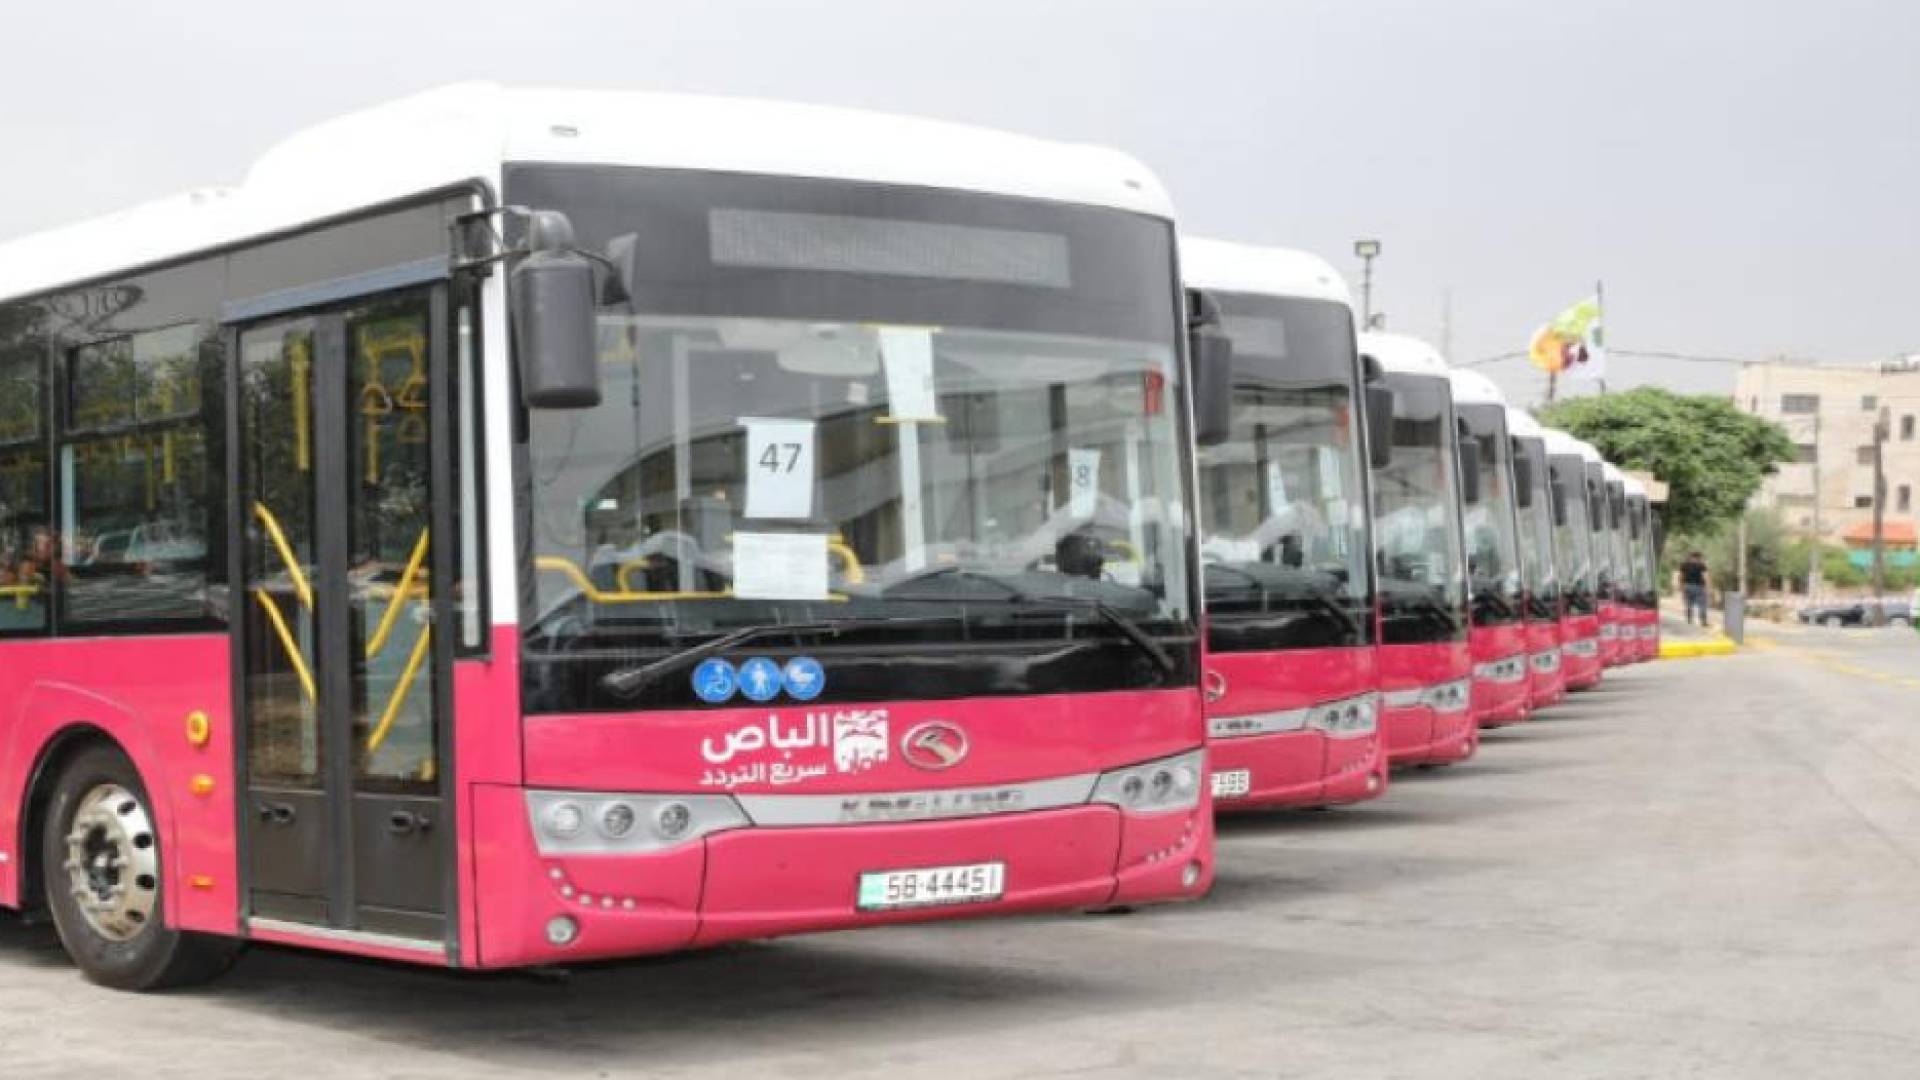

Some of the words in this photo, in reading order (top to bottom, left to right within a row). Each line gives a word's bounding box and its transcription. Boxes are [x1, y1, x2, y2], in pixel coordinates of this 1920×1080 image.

[759, 443, 803, 474] 47
[702, 712, 830, 763] الباص
[699, 763, 766, 789] التردد
[771, 763, 828, 785] سريع
